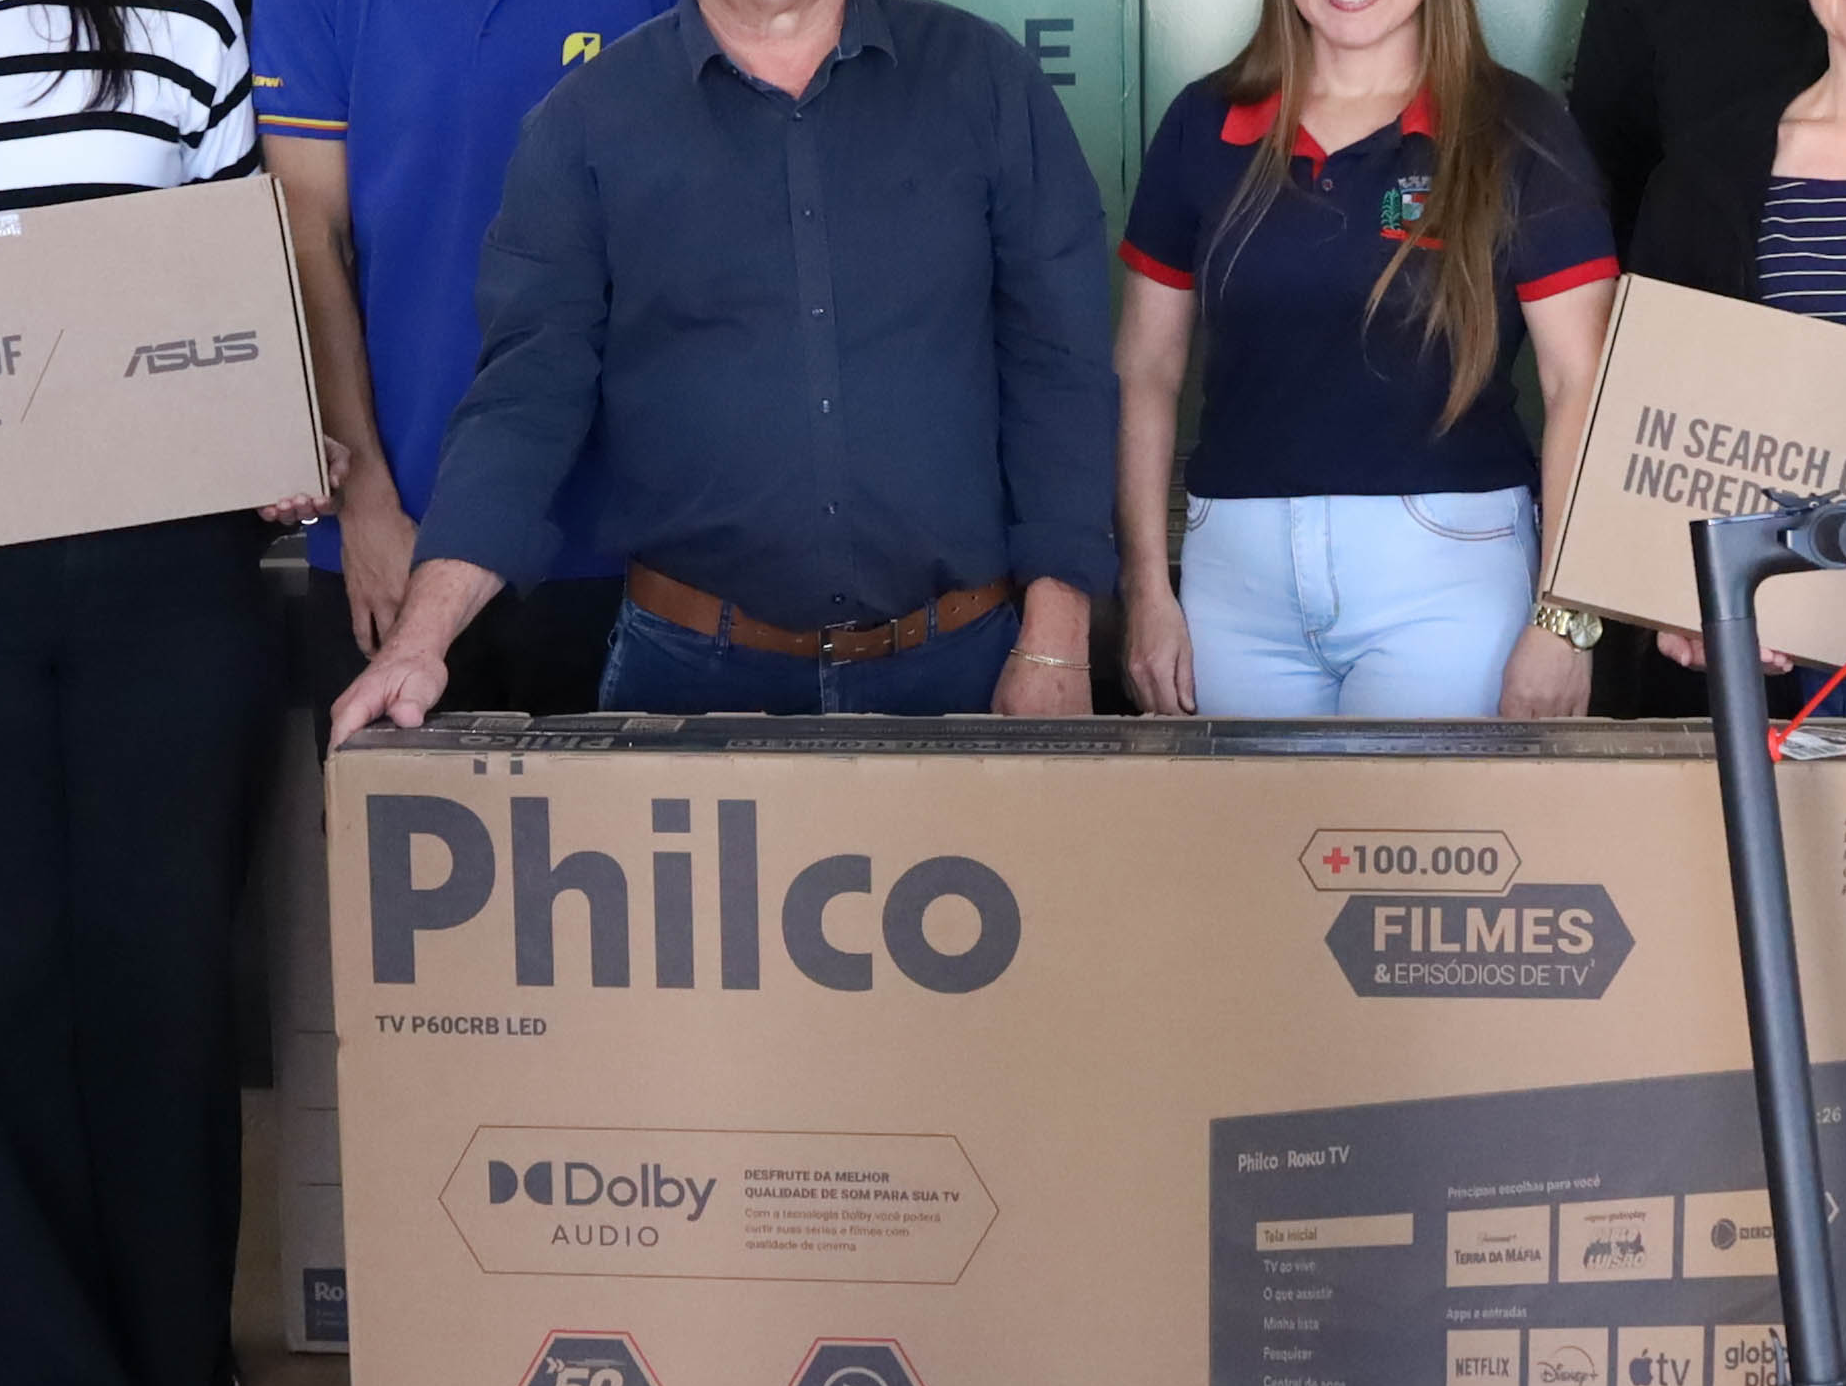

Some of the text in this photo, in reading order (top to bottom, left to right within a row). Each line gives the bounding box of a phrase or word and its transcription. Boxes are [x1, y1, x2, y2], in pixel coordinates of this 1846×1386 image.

[124, 330, 259, 378] ASUS
[1635, 405, 1677, 451] IN
[1683, 418, 1831, 488] SEARCH
[366, 795, 1021, 994] Philco
[1373, 906, 1595, 955] FILMES
[1520, 965, 1550, 986] DE
[375, 1015, 547, 1036] TV P60CRB LED
[1238, 1153, 1279, 1173] Philco
[1328, 1146, 1351, 1164] TV
[744, 1169, 890, 1183] DESFRUTE DA MELHOR
[565, 1162, 717, 1222] Dolby
[745, 1187, 960, 1202] QUALIDADE DE SOM PARA SUA TV
[551, 1225, 659, 1248] AUDIO
[1264, 1226, 1318, 1243] Tela inicial
[1455, 1356, 1510, 1378] NETFLIX
